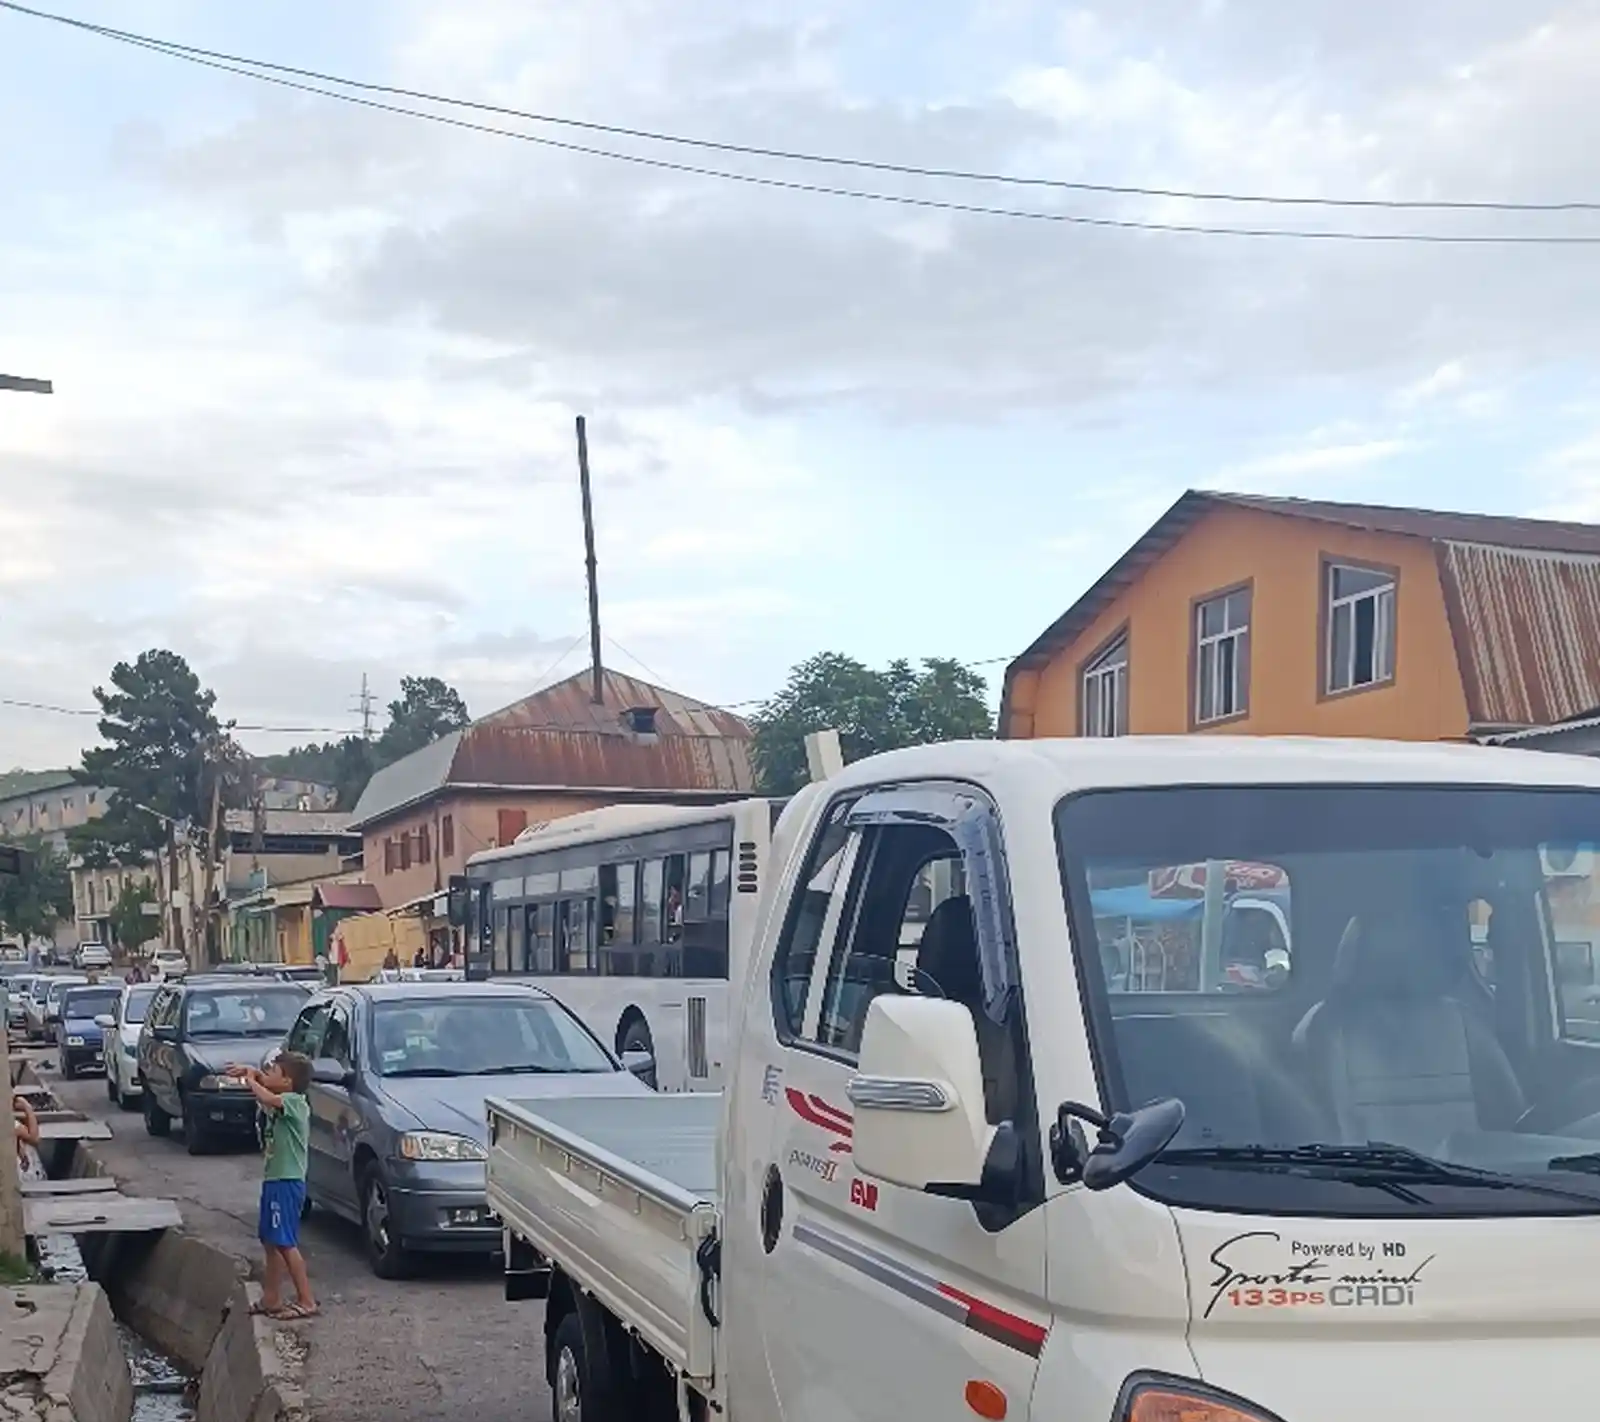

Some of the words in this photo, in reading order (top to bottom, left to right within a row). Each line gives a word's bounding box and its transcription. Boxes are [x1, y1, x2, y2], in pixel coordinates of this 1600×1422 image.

[1291, 1240, 1355, 1258] Powered
[1358, 1240, 1376, 1260] by
[1382, 1242, 1406, 1257] HD
